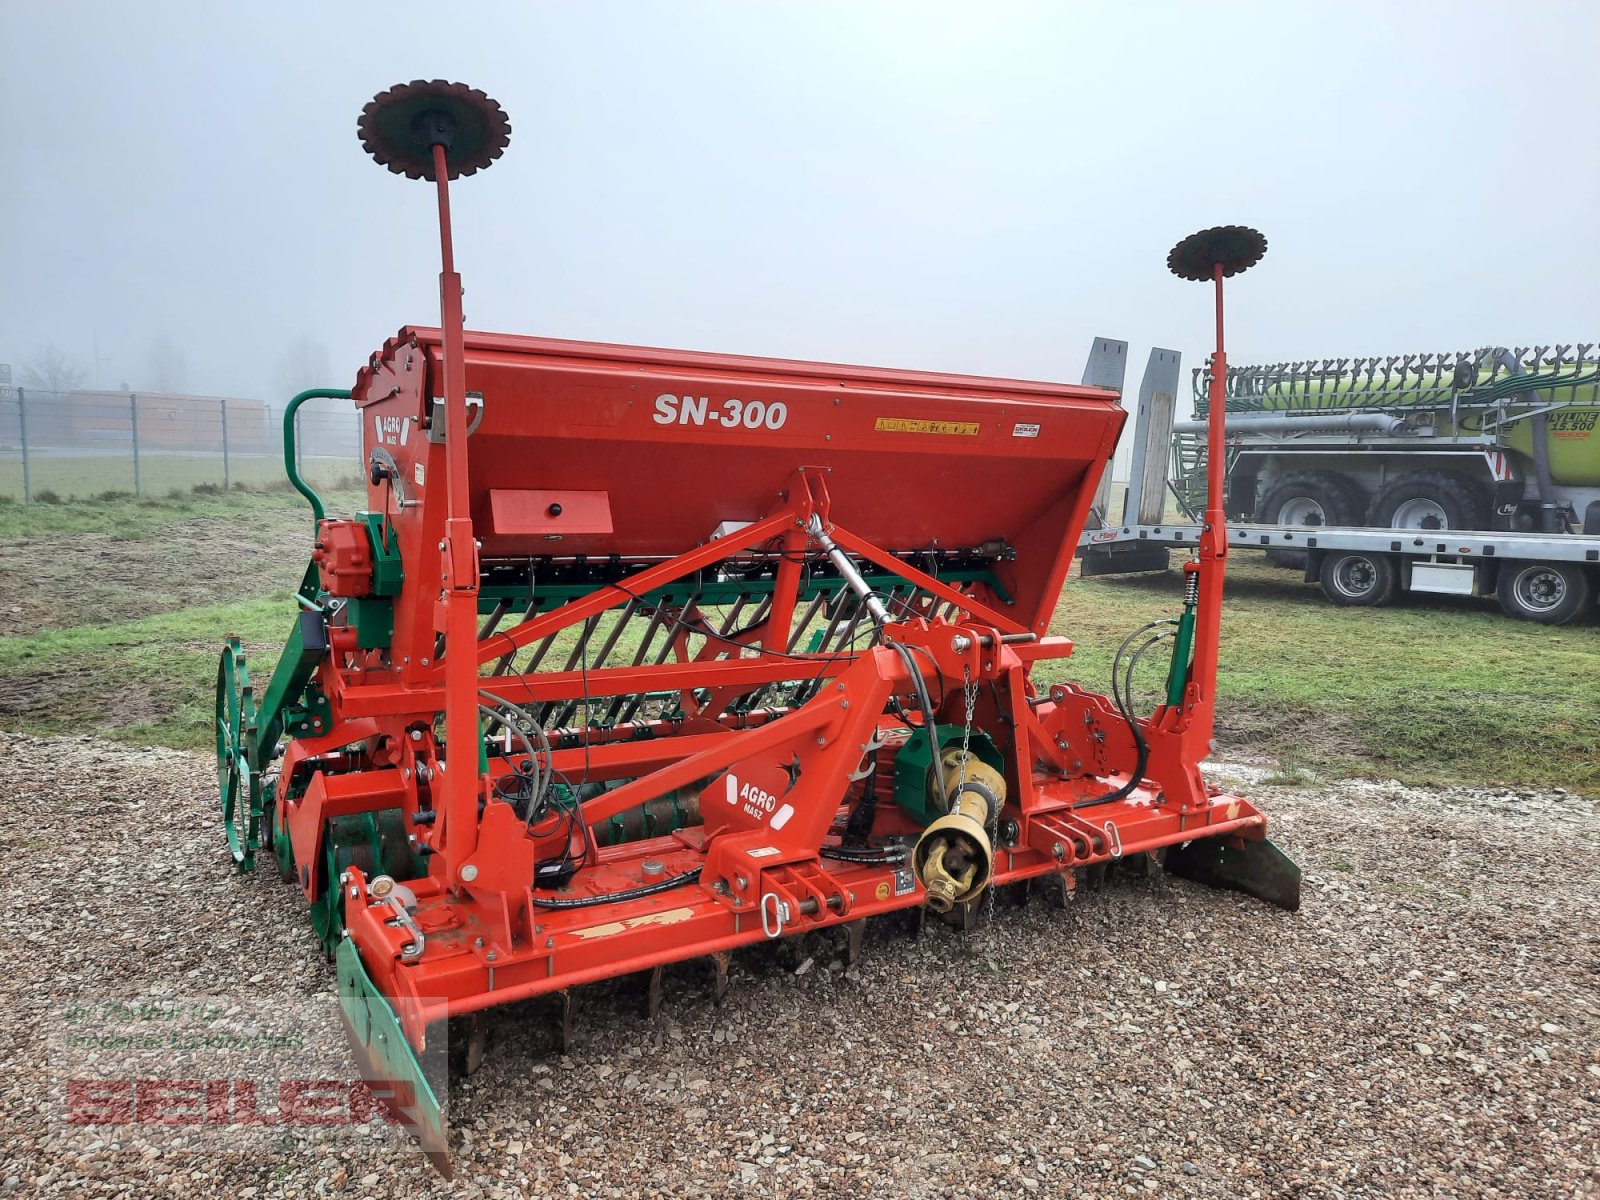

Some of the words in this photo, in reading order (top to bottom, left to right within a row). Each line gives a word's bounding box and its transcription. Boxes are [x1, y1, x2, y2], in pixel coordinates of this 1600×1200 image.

[652, 393, 788, 430] SN-300
[383, 416, 401, 434] AGRO
[1550, 422, 1596, 431] 15.500
[740, 782, 776, 813] AGRO
[743, 803, 764, 820] MASZ
